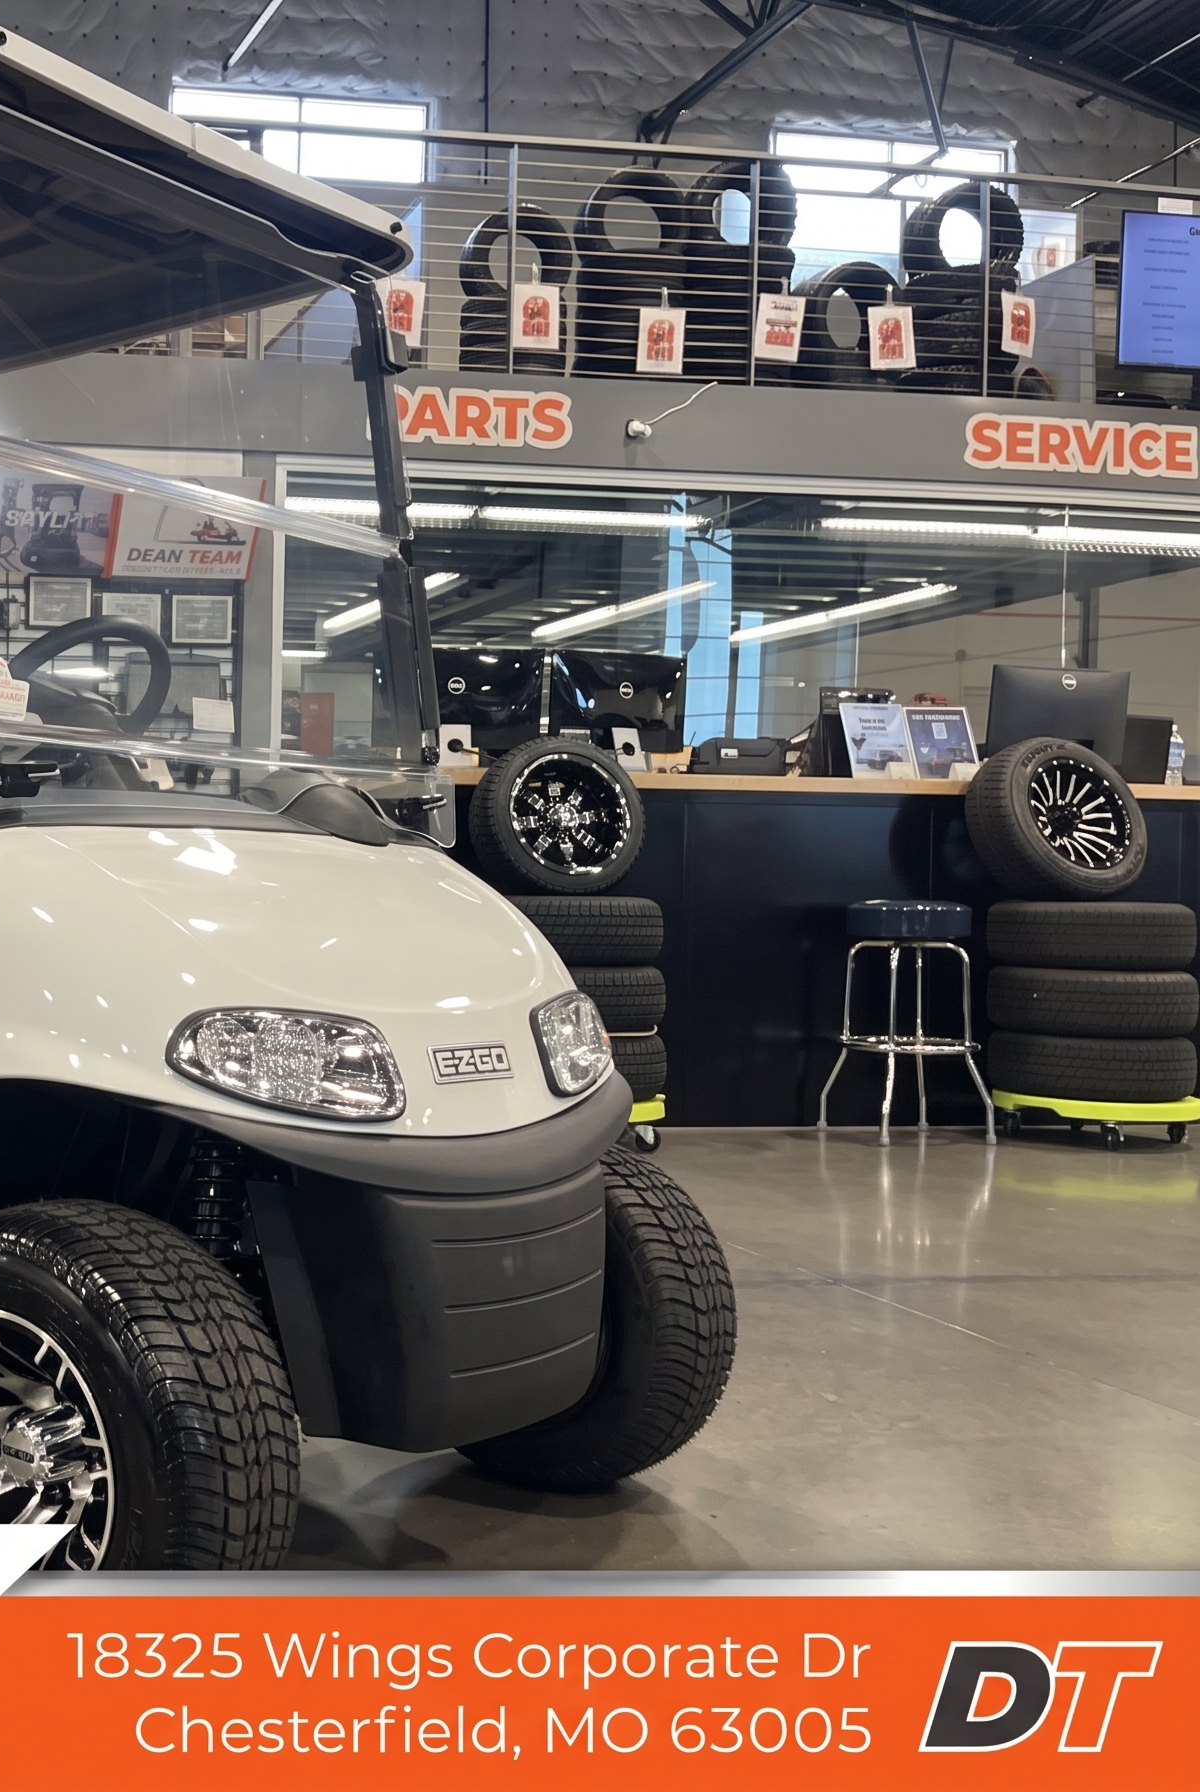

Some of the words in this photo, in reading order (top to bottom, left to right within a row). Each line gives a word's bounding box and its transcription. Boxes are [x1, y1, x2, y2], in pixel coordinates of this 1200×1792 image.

[971, 419, 1193, 472] SERVICE
[126, 547, 184, 564] DEAN
[188, 550, 243, 565] TEAM
